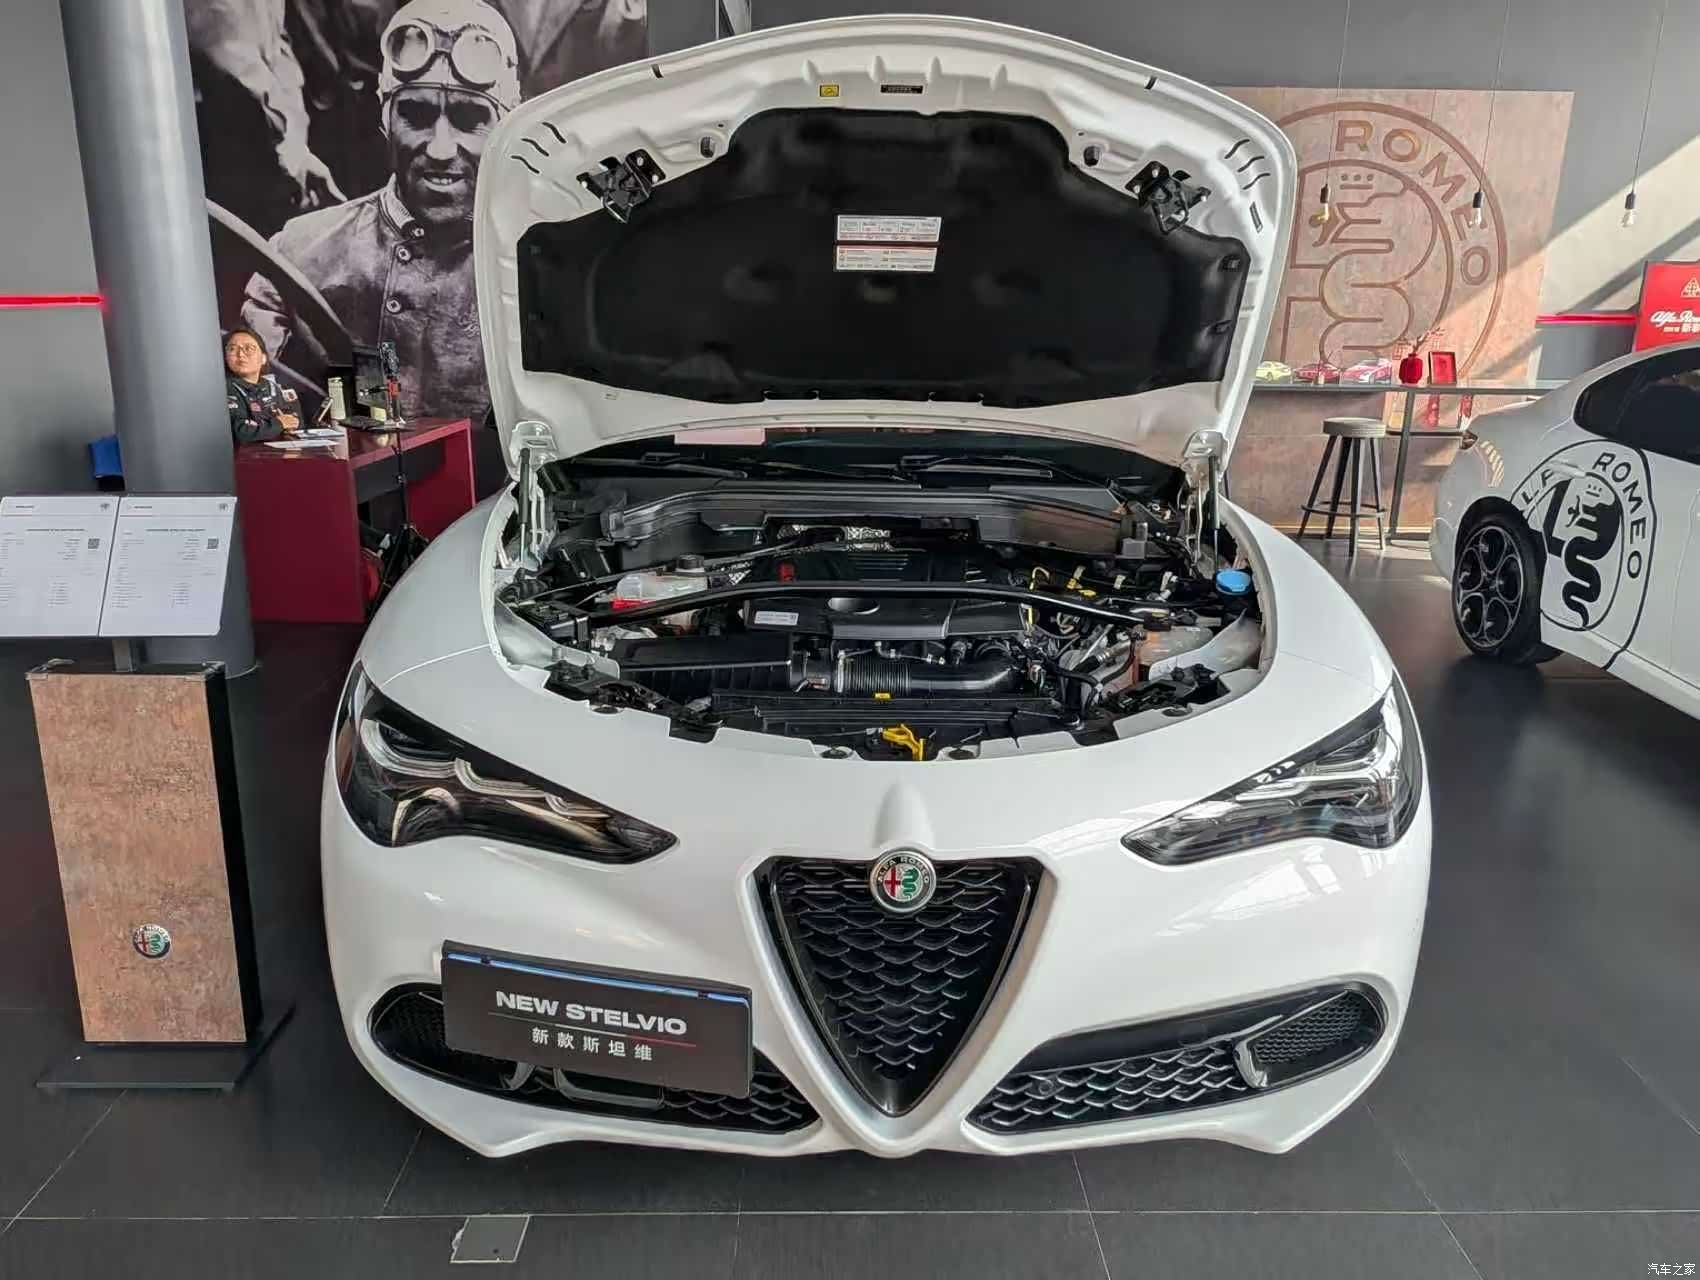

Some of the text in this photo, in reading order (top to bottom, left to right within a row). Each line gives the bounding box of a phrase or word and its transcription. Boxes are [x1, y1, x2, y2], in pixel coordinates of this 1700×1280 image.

[1336, 119, 1491, 285] ROMEO
[1592, 452, 1646, 579] ROMEO
[495, 991, 687, 1034] NEW STELVIO
[532, 1028, 653, 1061] 新款斯坦维
